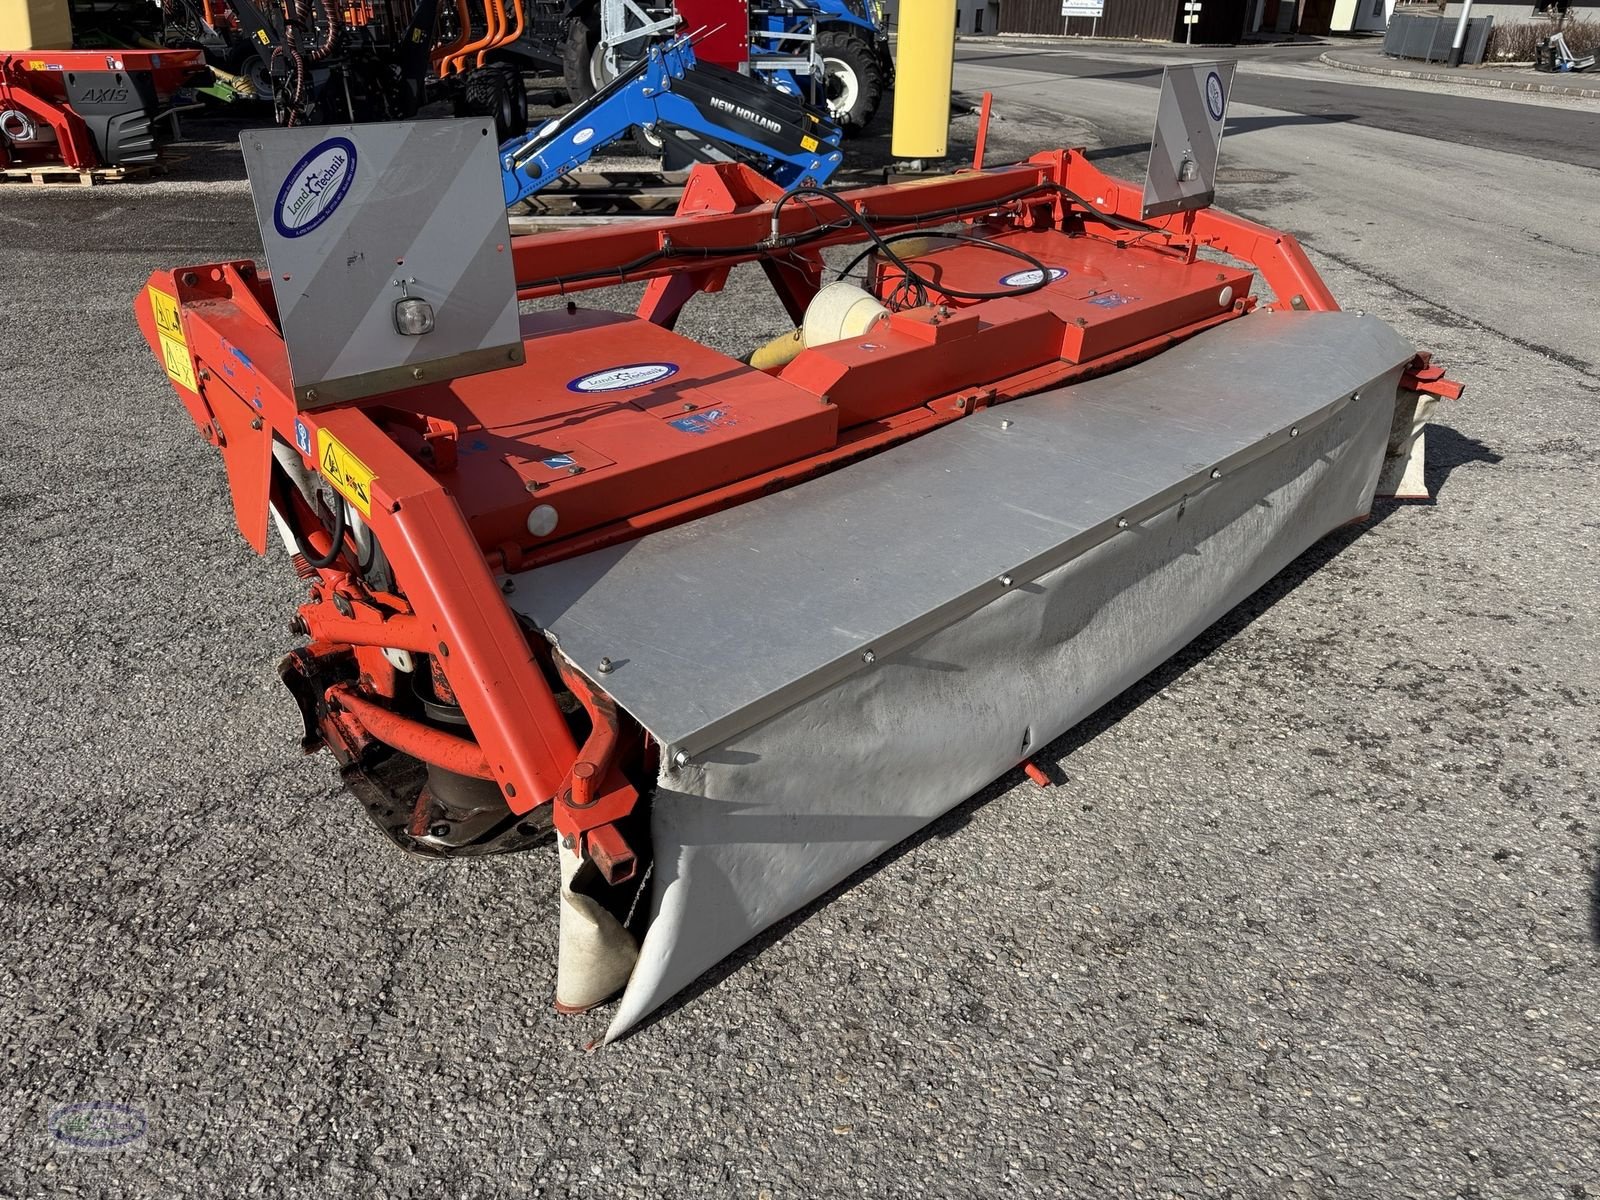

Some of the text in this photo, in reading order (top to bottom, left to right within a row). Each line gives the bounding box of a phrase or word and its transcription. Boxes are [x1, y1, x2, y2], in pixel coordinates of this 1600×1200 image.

[79, 89, 129, 103] AXIS
[710, 97, 782, 133] NEW HOLLAND
[287, 188, 309, 215] Land
[314, 155, 345, 190] Technik
